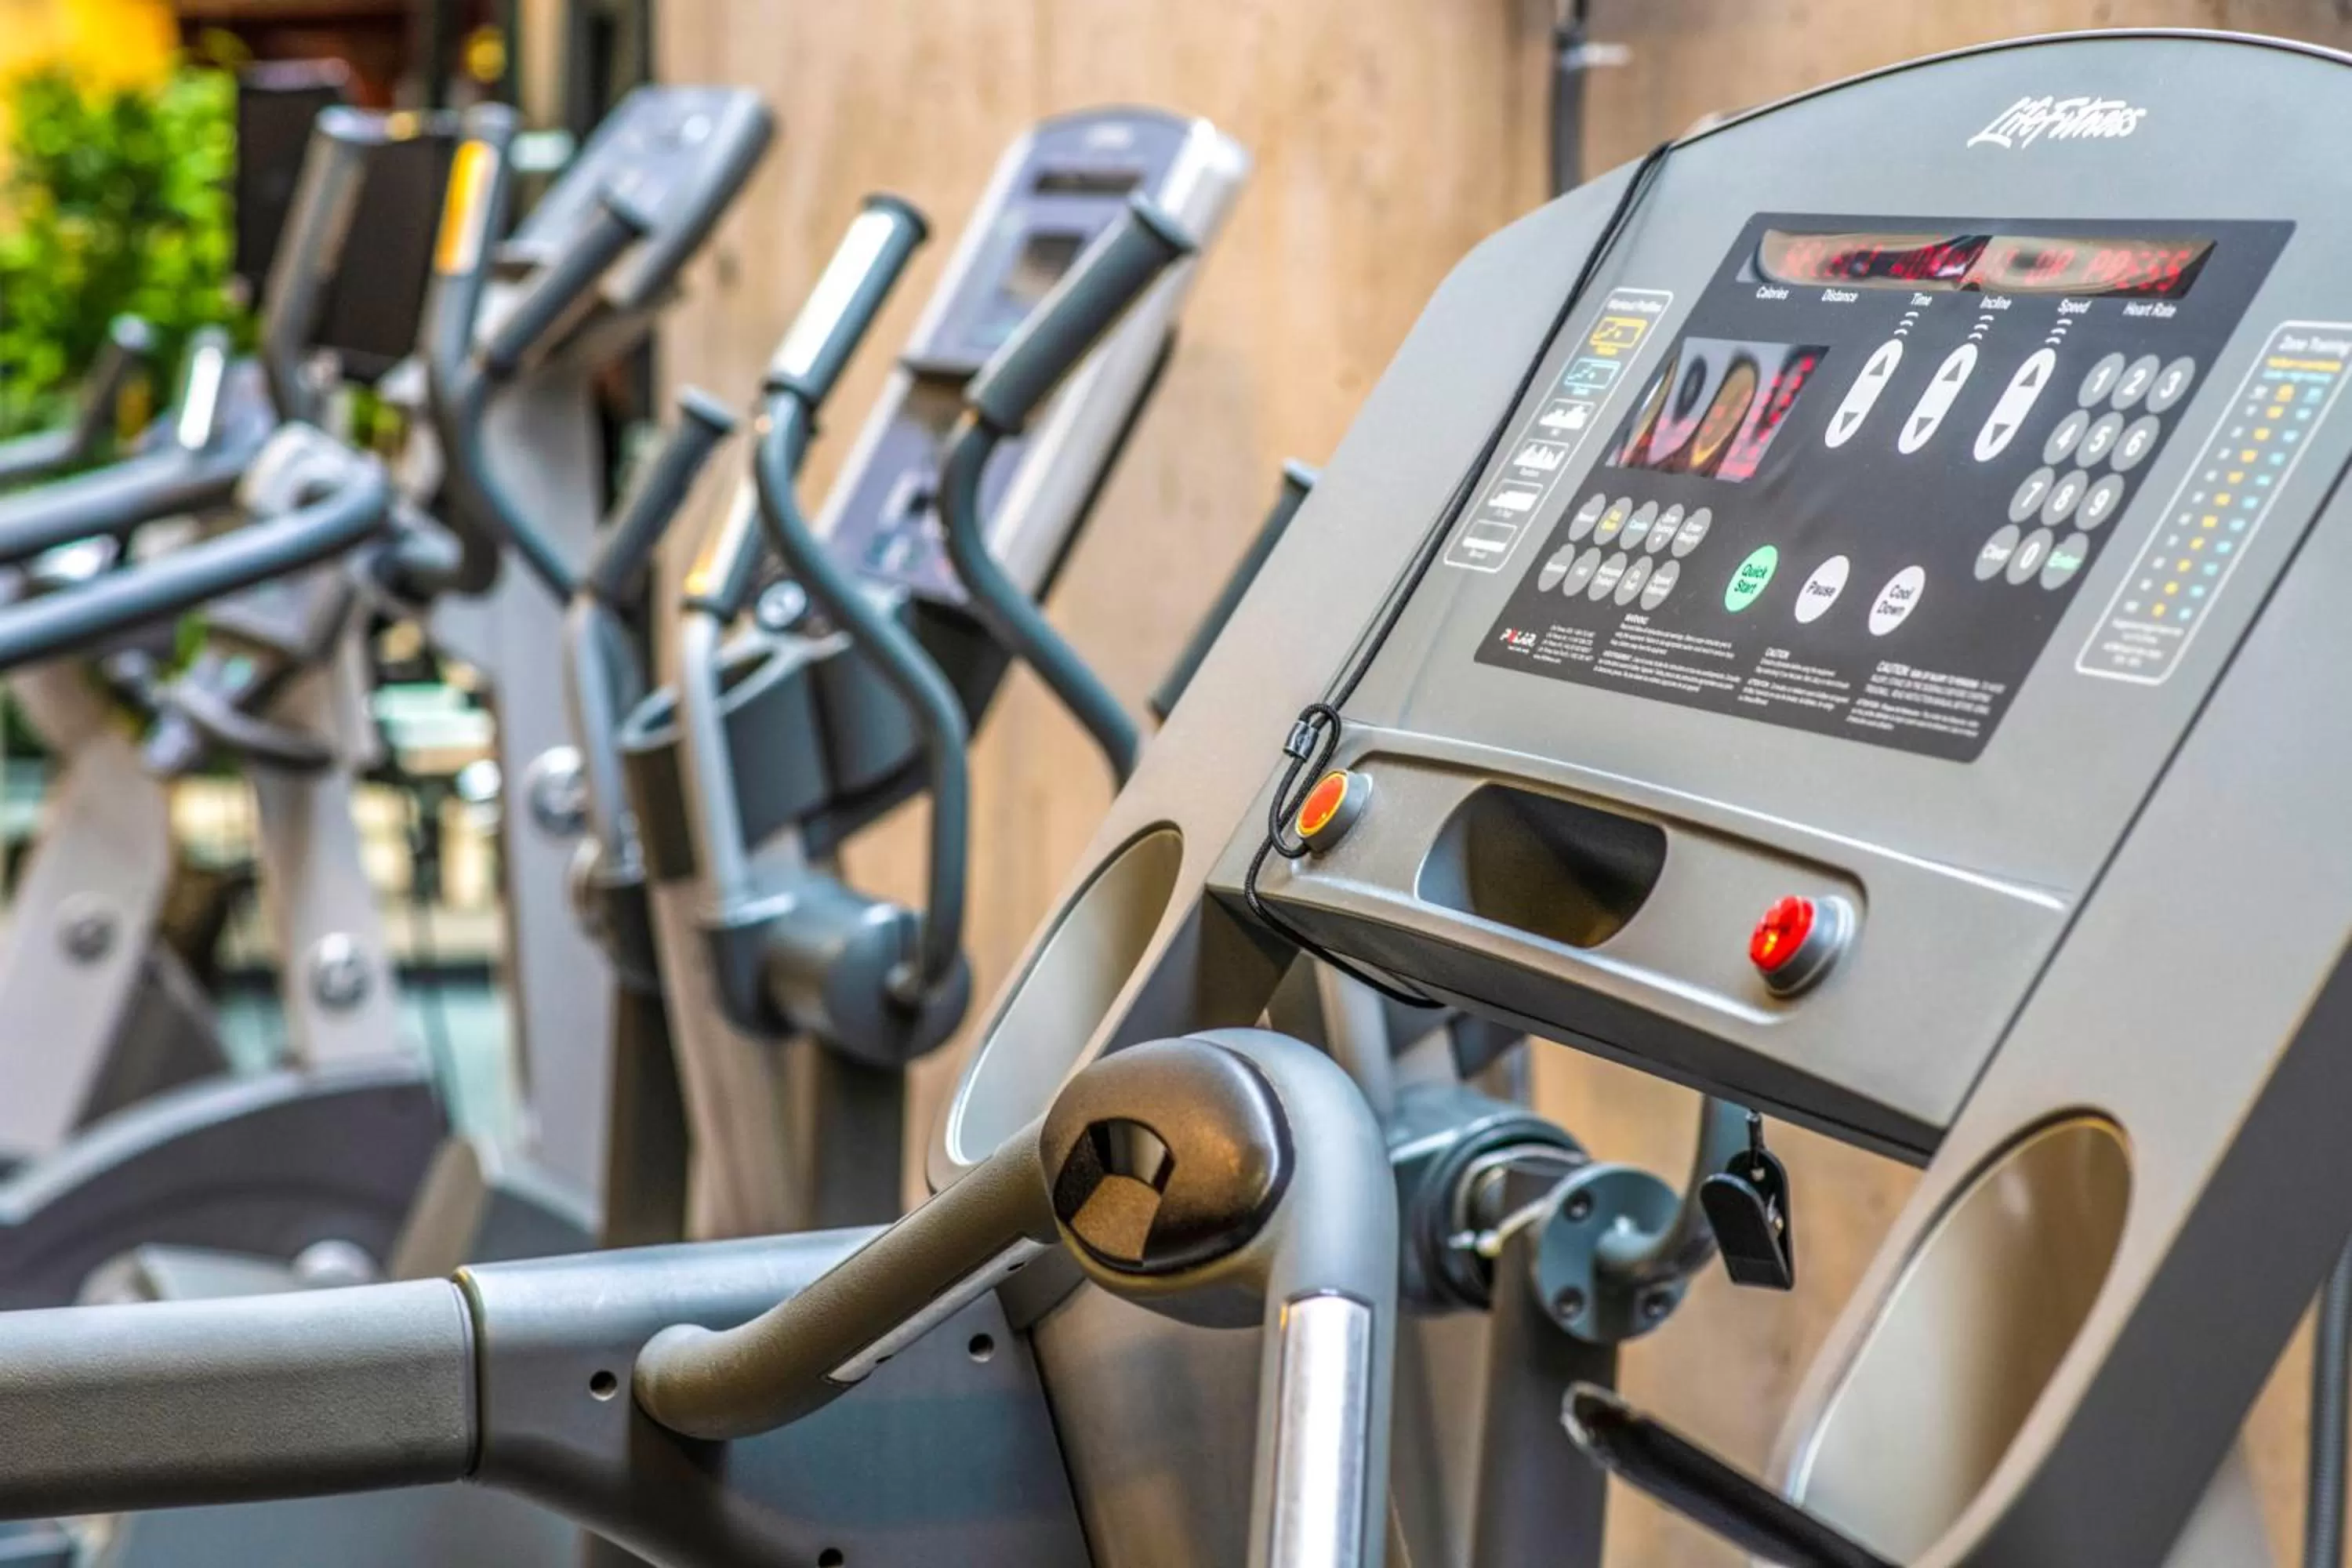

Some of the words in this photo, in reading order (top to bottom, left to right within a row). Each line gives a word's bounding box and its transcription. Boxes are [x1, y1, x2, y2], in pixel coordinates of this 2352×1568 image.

[1755, 285, 1790, 300] Calories
[1821, 288, 1858, 303] Distance
[1910, 292, 1933, 307] Time
[1979, 295, 2012, 310] Incline
[2057, 298, 2092, 315] Speed
[2122, 301, 2151, 317] Heart
[2151, 302, 2178, 318] Rate
[2092, 367, 2111, 393] 1
[2122, 368, 2147, 395] 2
[2160, 371, 2183, 398] 3
[2056, 423, 2078, 451] 4
[2088, 426, 2113, 452] 5
[2123, 429, 2147, 457] 6
[2021, 481, 2044, 508] 7
[2053, 484, 2075, 511] 8
[2089, 488, 2111, 516] 9
[2020, 542, 2041, 569] 0
[1740, 563, 1769, 580] Quick
[1733, 579, 1758, 595] Start
[1806, 580, 1837, 598] Pause
[1889, 584, 1915, 601] Cool
[1876, 600, 1906, 617] Down
